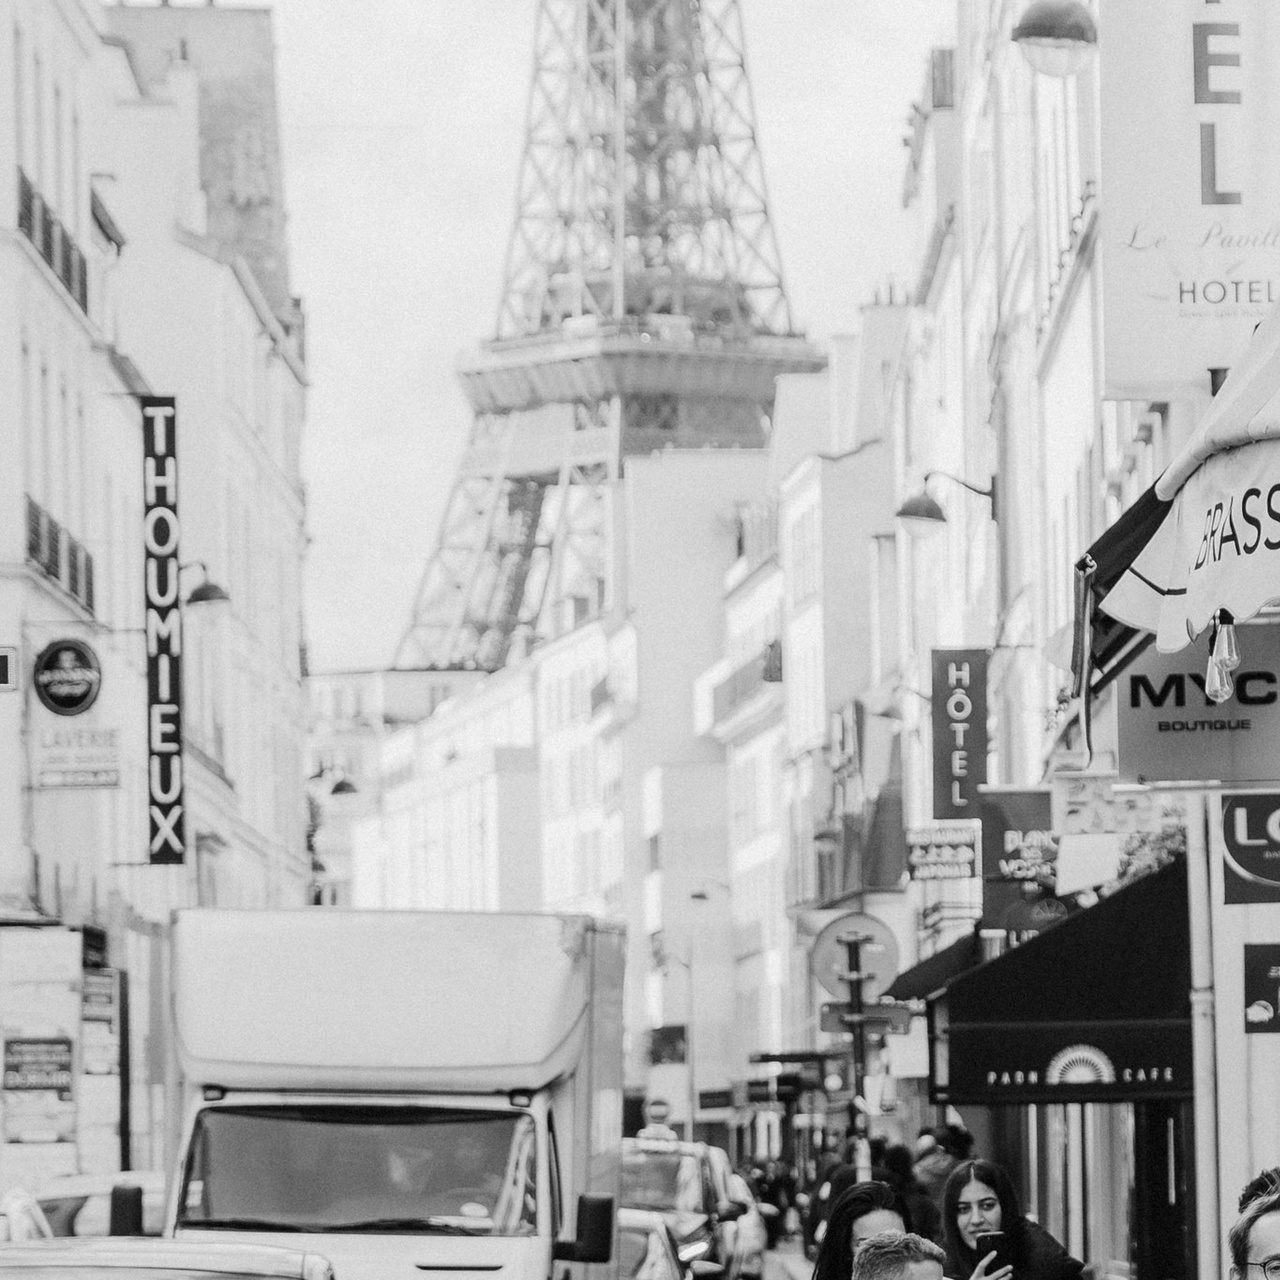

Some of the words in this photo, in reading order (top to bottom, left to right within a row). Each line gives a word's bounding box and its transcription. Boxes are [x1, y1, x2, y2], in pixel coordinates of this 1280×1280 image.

[1178, 280, 1276, 304] HOTEL
[143, 405, 184, 856] THOUMIEUX
[1158, 719, 1252, 732] BOUTIQUE
